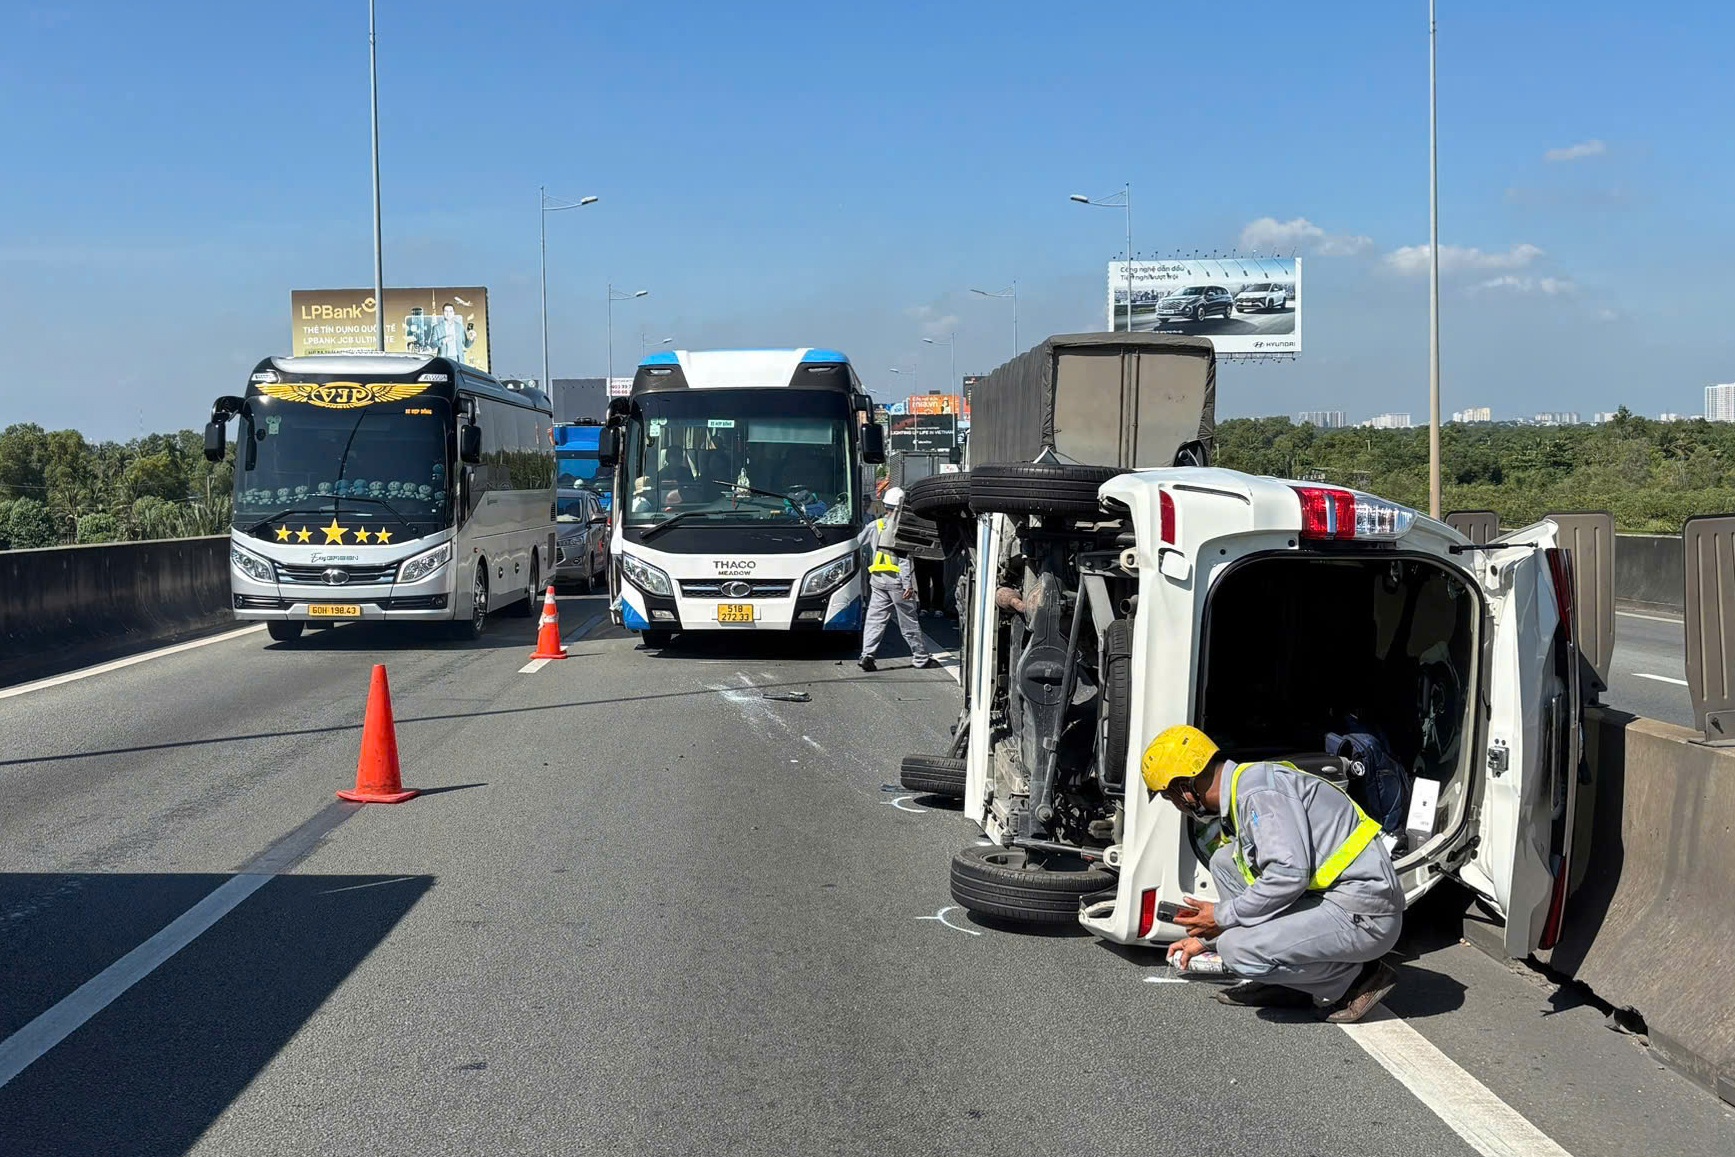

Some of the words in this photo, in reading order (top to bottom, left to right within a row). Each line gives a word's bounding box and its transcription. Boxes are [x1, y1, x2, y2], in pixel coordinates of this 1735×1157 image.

[301, 304, 363, 320] LPBank
[321, 324, 335, 334] TÍN
[303, 337, 337, 345] LPBANK
[712, 560, 757, 569] THACO
[727, 604, 743, 612] 51B
[721, 613, 749, 621] 272.33
